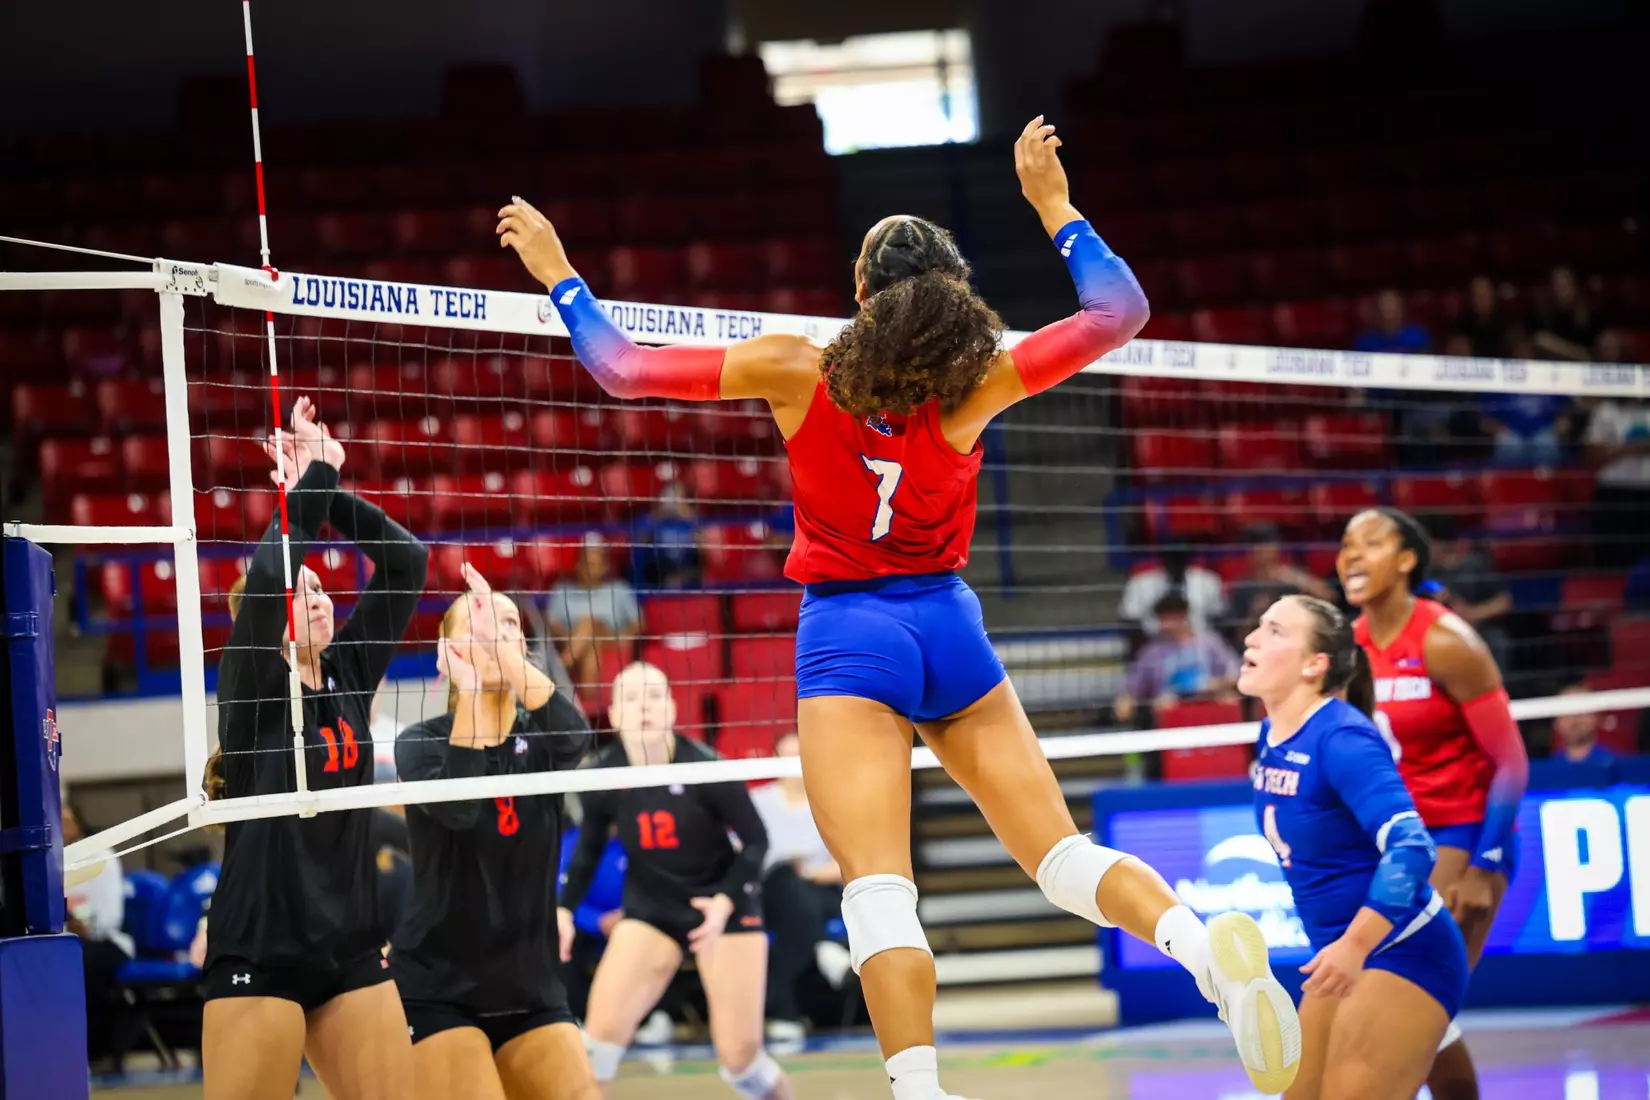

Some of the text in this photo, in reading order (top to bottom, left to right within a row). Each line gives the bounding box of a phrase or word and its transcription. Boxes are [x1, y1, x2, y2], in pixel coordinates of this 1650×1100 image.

[292, 276, 488, 320] LOUISIANA TECH
[602, 303, 763, 340] OUISIANA TECH
[858, 451, 904, 541] 7
[636, 809, 680, 850] 12
